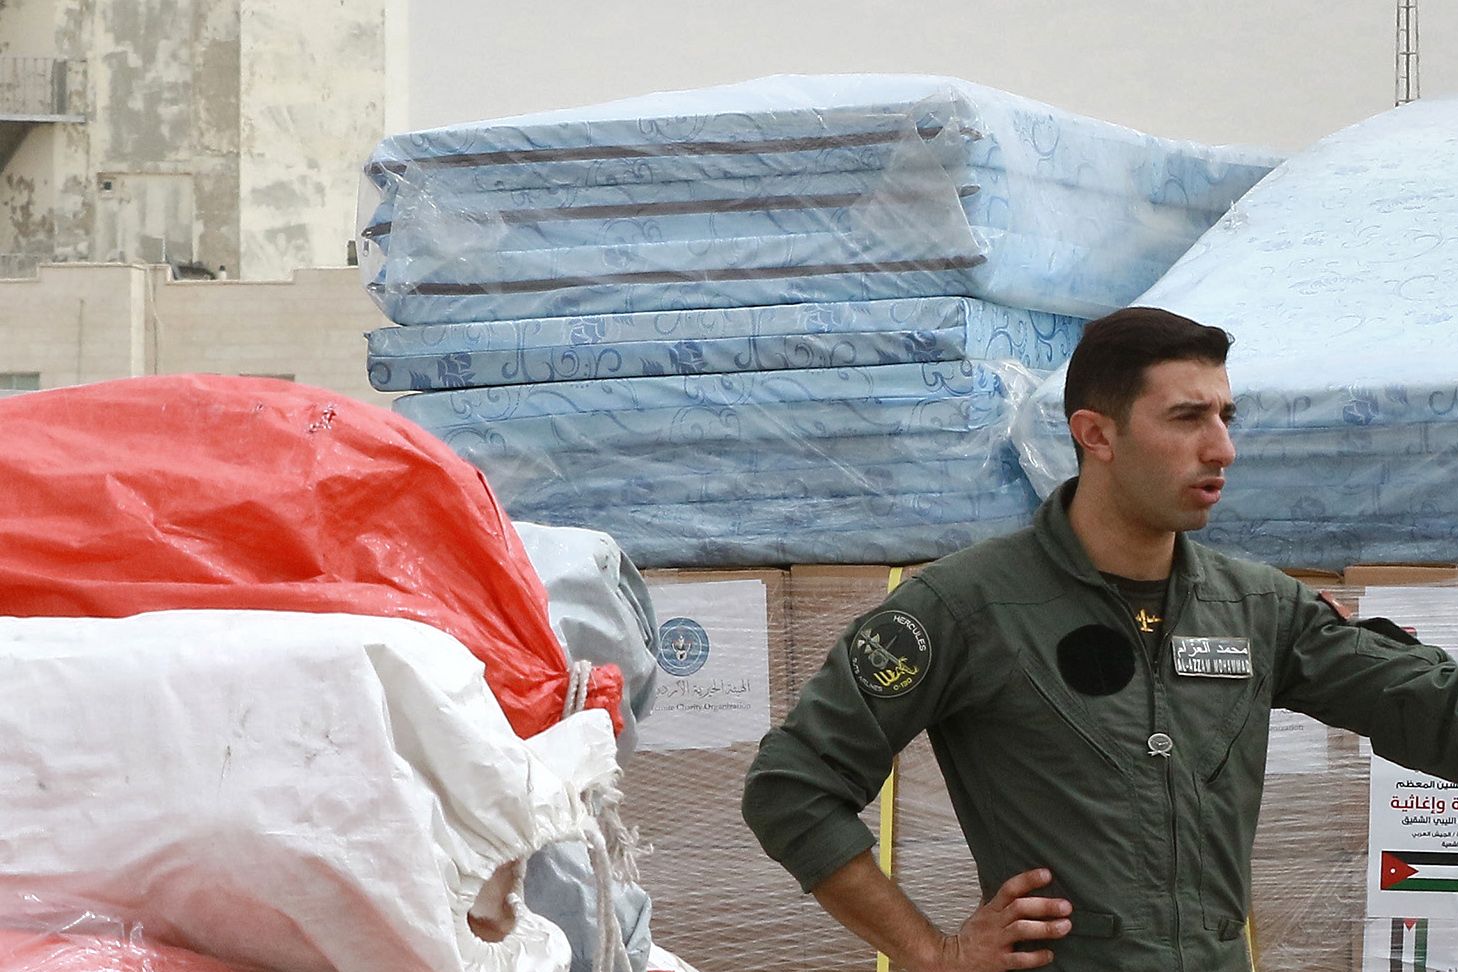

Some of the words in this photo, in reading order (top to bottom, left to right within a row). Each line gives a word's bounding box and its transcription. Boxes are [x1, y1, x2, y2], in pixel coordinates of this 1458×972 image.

[893, 615, 927, 652] HERCULES
[1216, 644, 1248, 655] محمد
[1395, 780, 1435, 791] المعظم
[1390, 794, 1446, 816] وإغاثية
[1401, 815, 1432, 827] الشقيق
[1433, 816, 1457, 827] الليبي
